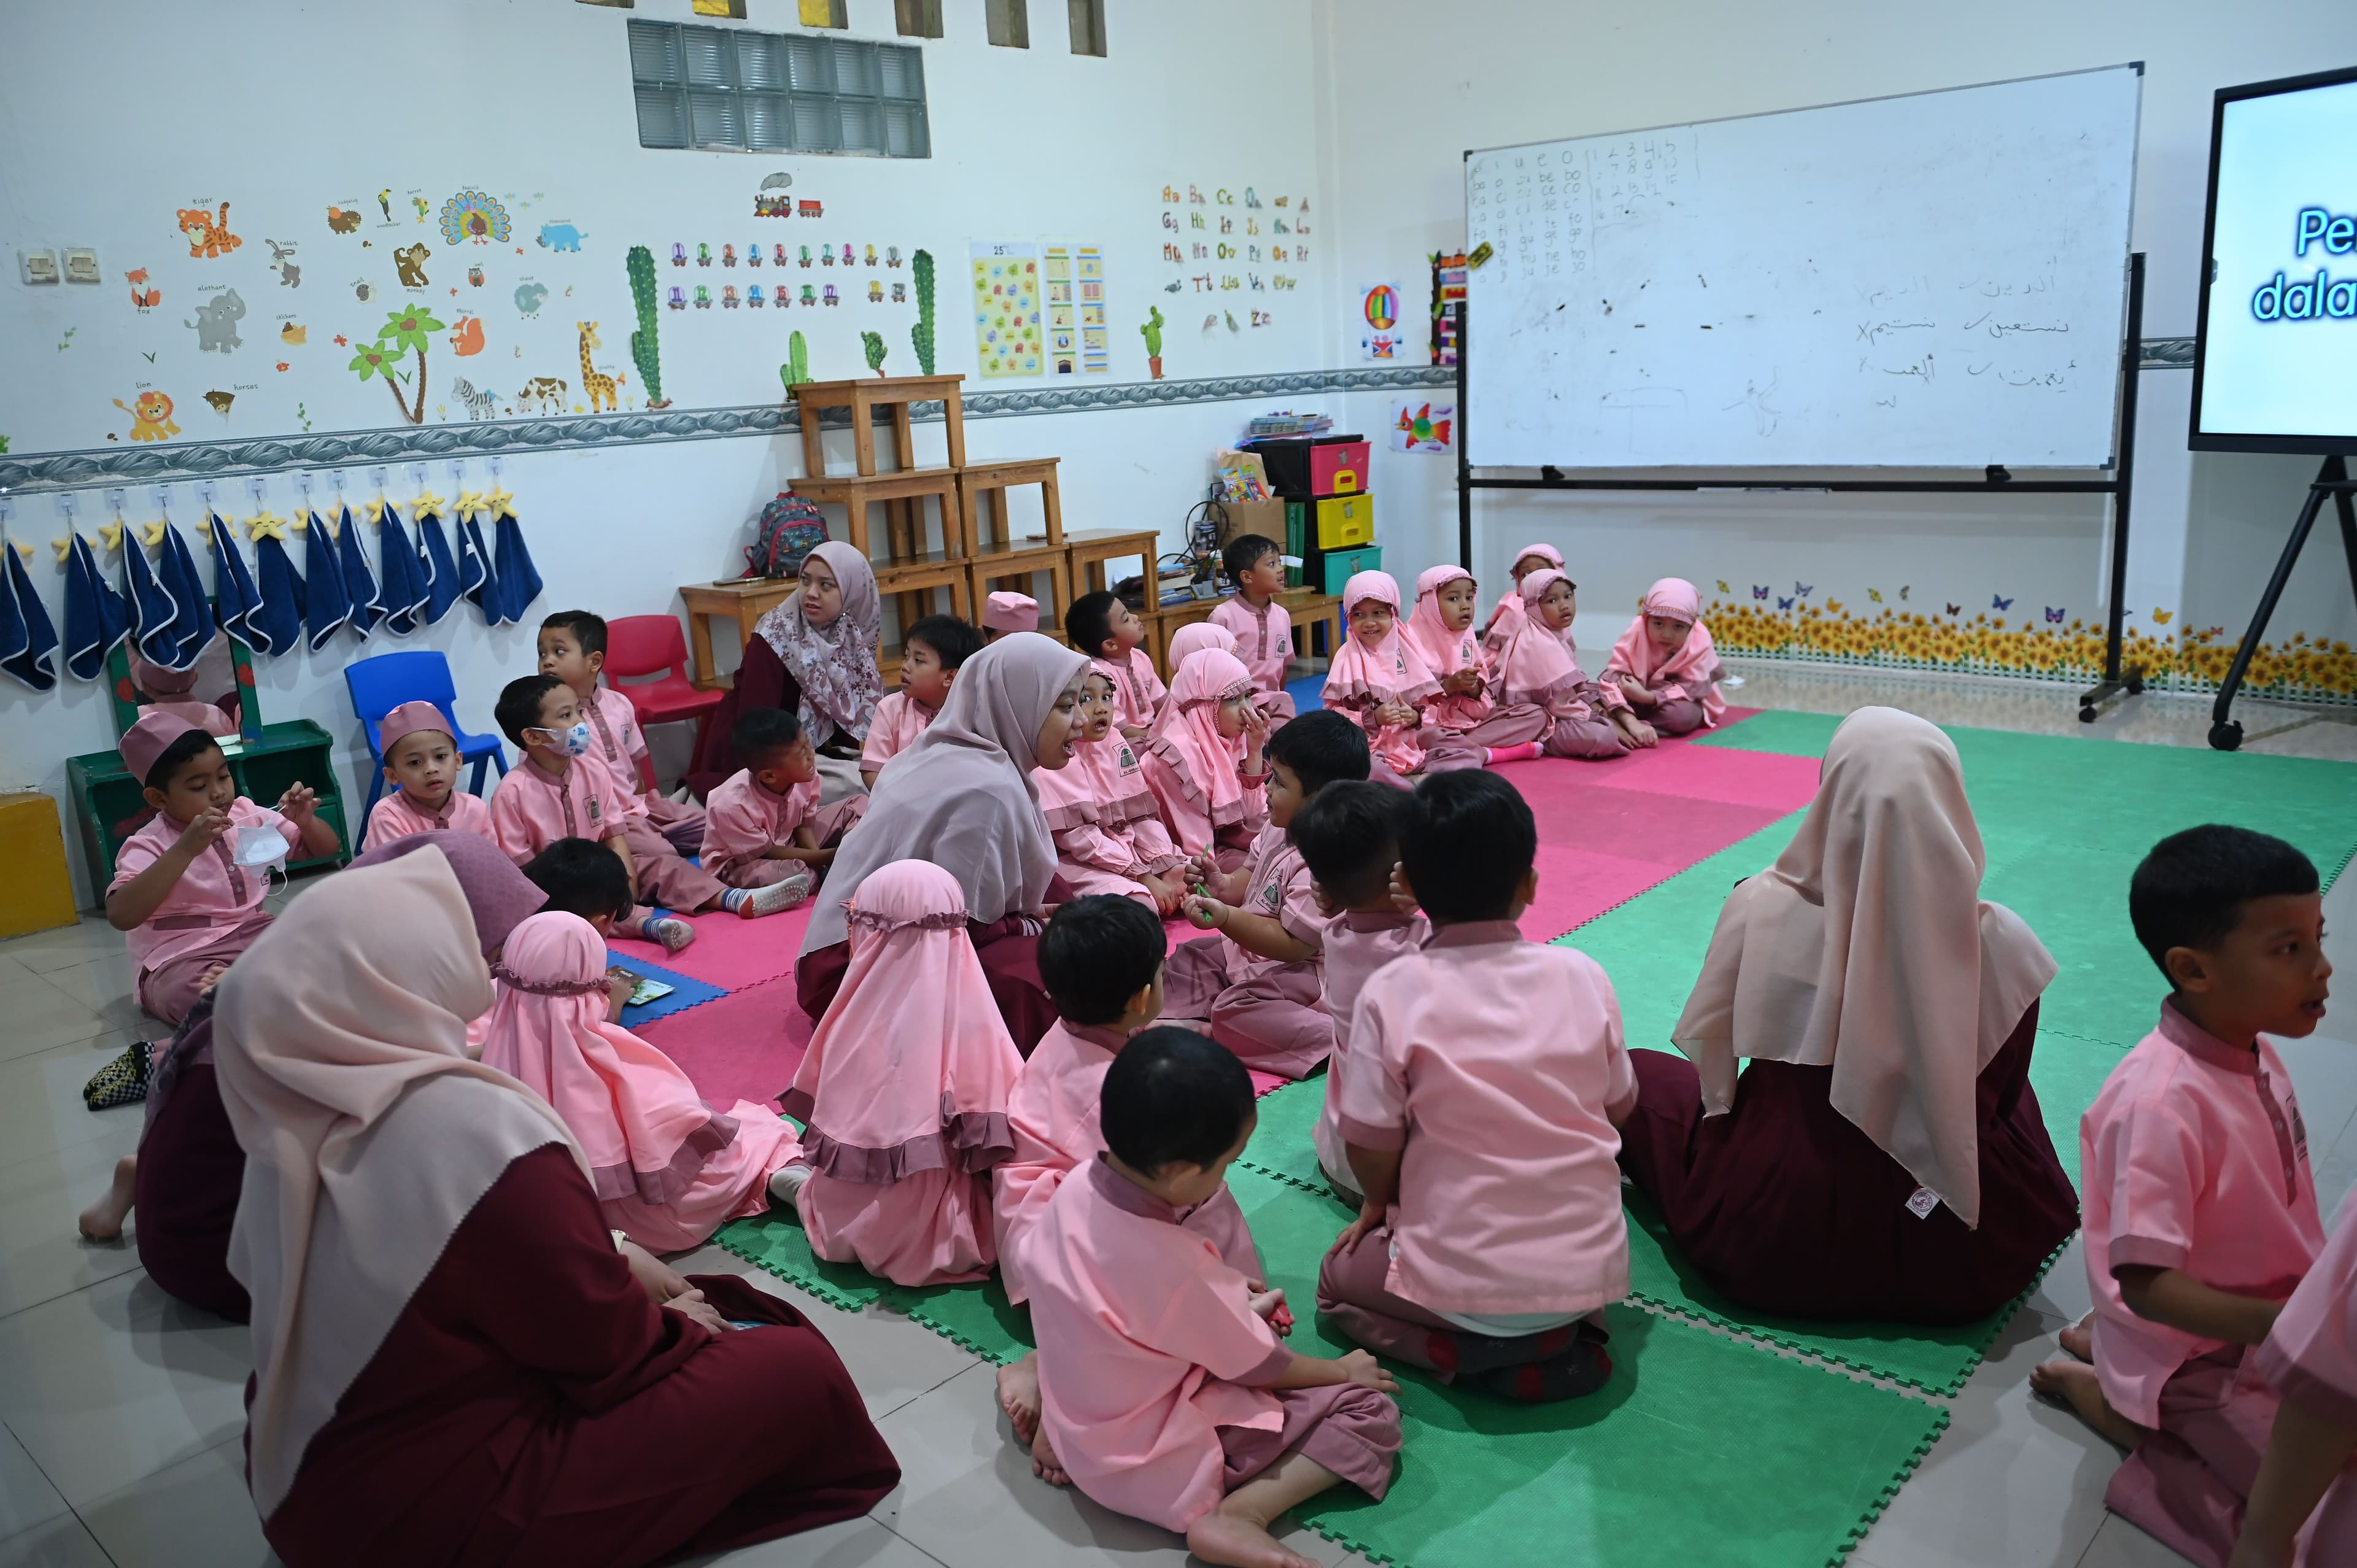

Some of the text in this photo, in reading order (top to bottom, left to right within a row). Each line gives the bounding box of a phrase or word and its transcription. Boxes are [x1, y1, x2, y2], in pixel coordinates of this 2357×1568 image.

[1627, 142, 1636, 157] 3
[1163, 185, 1180, 203] Aa
[193, 197, 213, 207] tiger
[2296, 207, 2357, 257] Pe
[994, 245, 1004, 255] 25
[350, 276, 365, 288] snail
